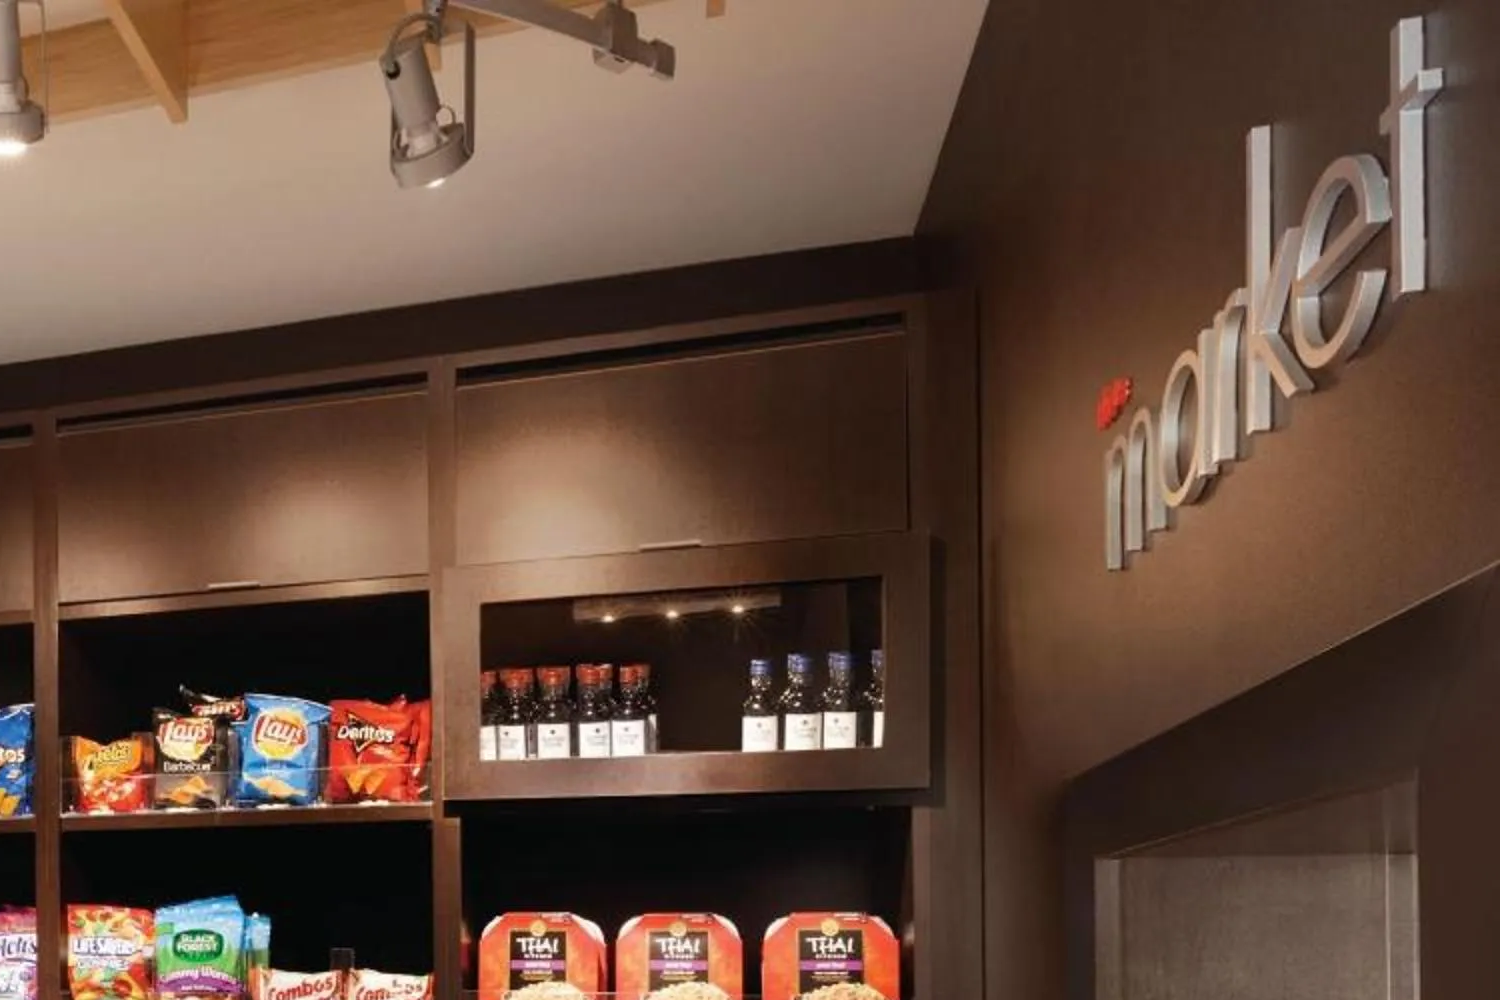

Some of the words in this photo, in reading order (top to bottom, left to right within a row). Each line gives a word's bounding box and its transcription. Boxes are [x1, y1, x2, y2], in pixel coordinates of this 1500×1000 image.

[1106, 16, 1443, 571] market
[337, 725, 395, 742] Doritos
[516, 937, 558, 954] THAI
[656, 937, 699, 955] THAI
[805, 937, 853, 955] THAI
